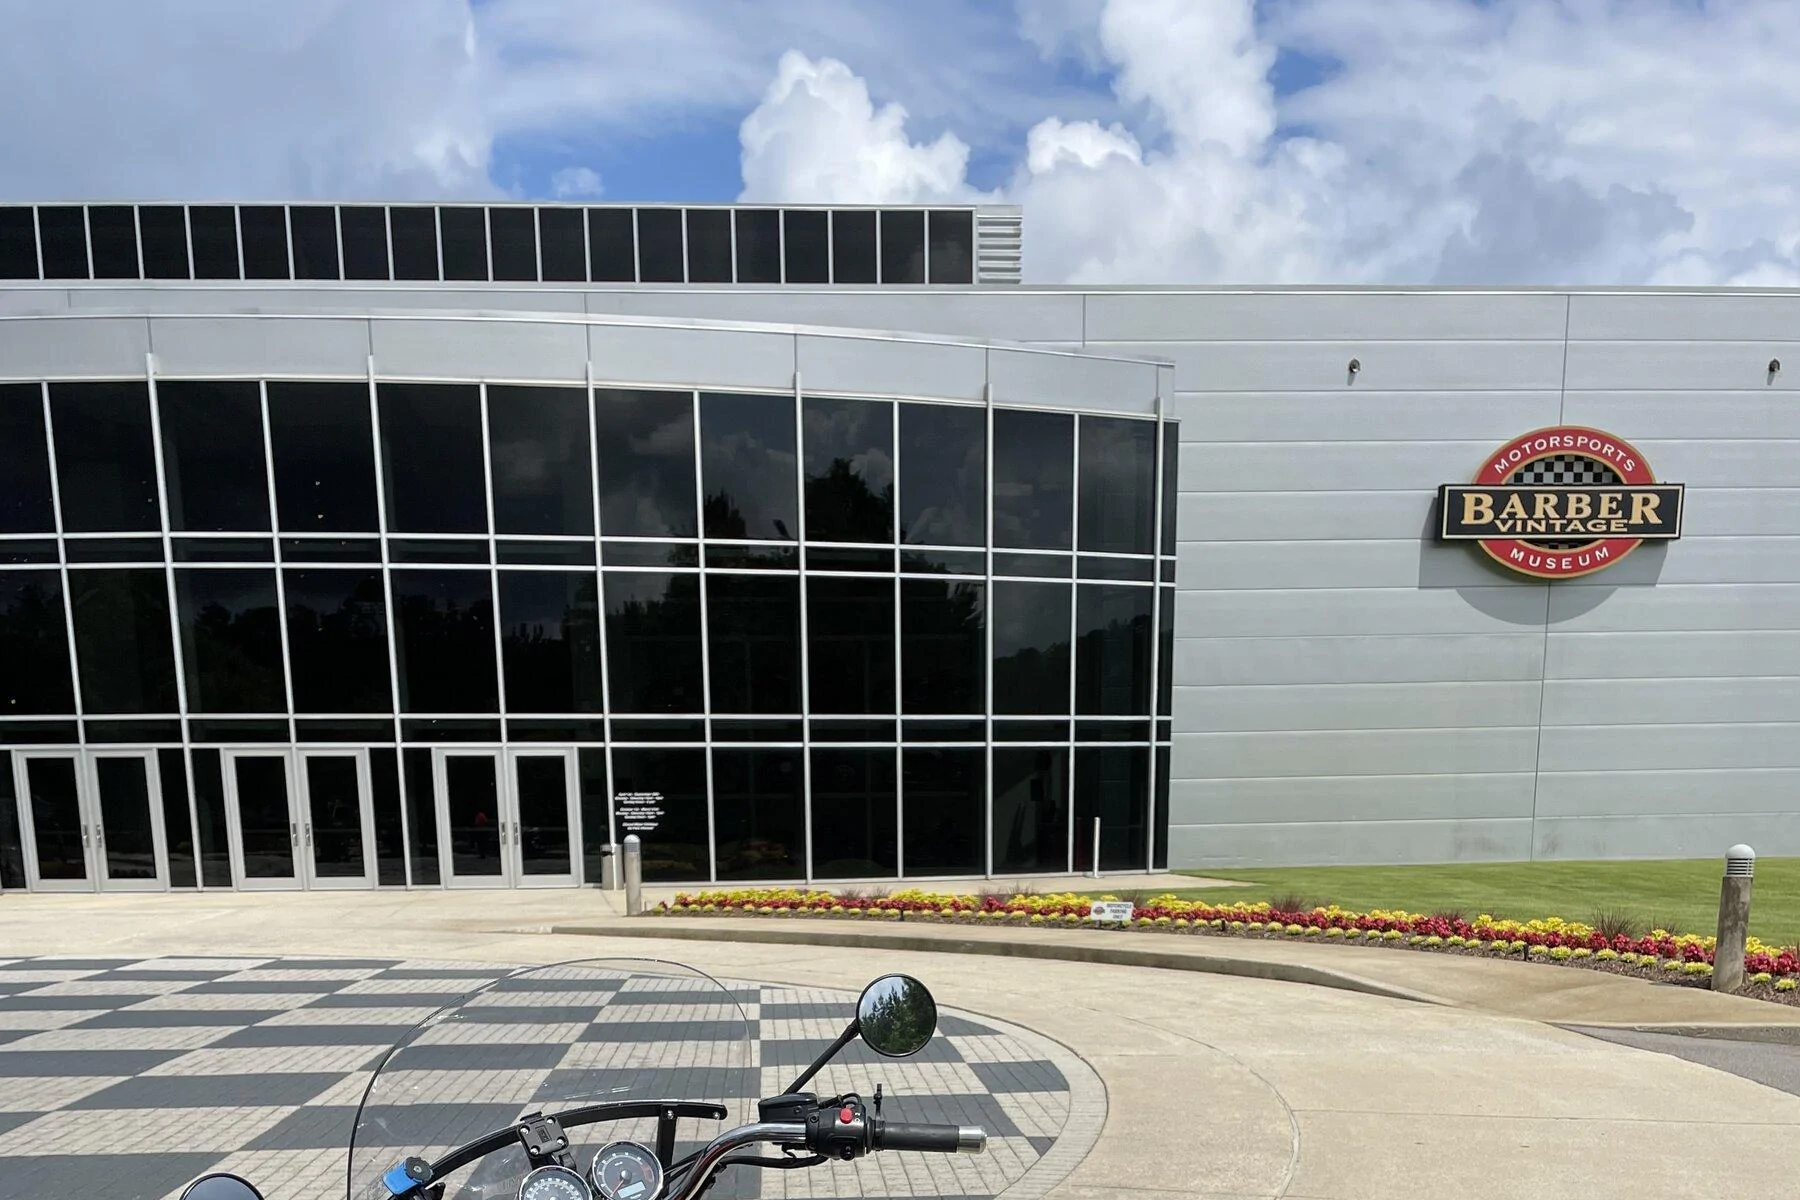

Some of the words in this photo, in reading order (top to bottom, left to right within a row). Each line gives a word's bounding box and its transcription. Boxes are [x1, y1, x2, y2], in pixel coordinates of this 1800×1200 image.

[1494, 435, 1636, 474] MOTORSPORTS
[1461, 492, 1663, 525] BARBER
[1494, 519, 1629, 533] VINTAGE
[1510, 546, 1610, 570] MUSEUM
